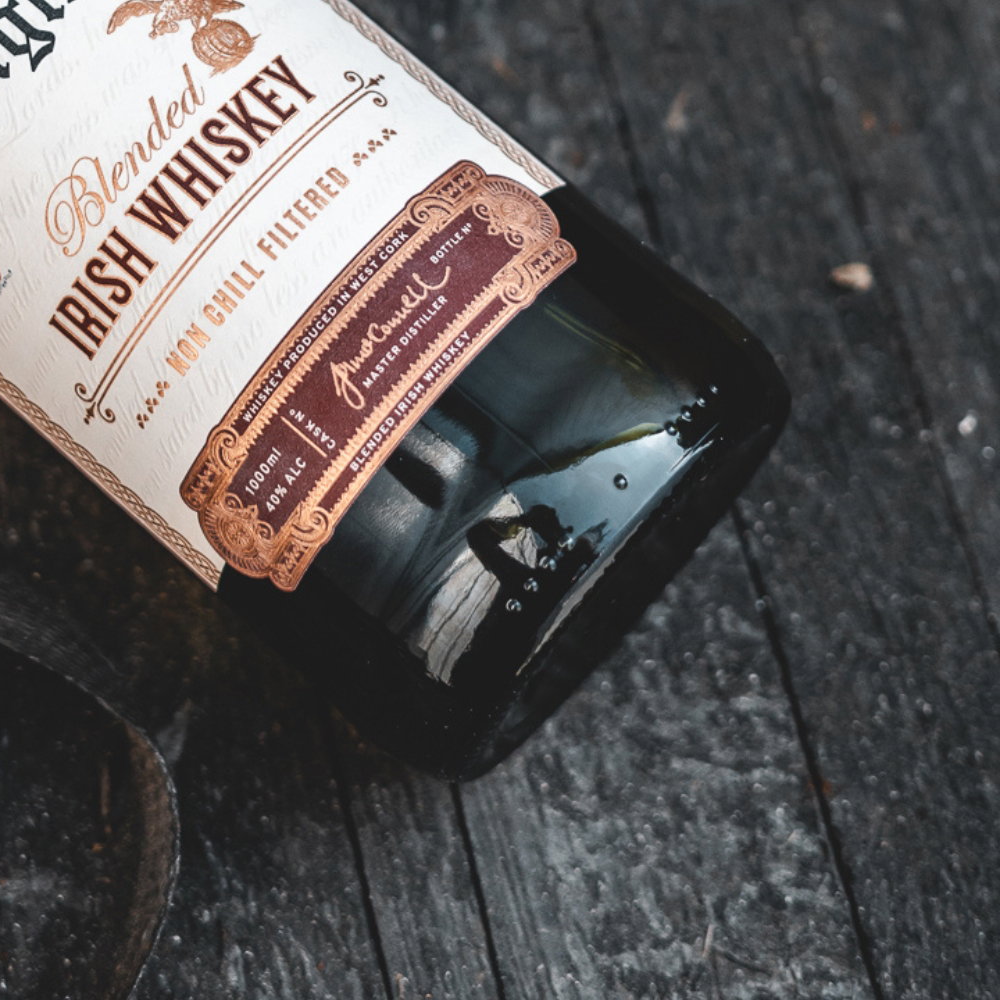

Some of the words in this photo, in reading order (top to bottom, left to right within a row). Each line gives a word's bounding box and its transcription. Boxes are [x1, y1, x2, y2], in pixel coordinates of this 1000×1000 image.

[47, 63, 204, 257] Blended
[49, 227, 154, 360] IRISH
[125, 56, 315, 240] WHISKEY
[165, 322, 210, 376] NON
[203, 260, 264, 326] CHILL
[257, 167, 348, 260] FILTERED
[430, 232, 463, 264] BOTTLE
[241, 370, 287, 425] WHISKEY
[284, 307, 336, 369] PRODUCED
[337, 291, 350, 305] IN
[350, 258, 378, 294] WEST
[379, 226, 408, 264] CORK
[363, 346, 400, 388] MASTER
[400, 296, 447, 345] DISTILLER
[306, 420, 335, 449] CASK
[349, 417, 395, 471] BLENDED
[394, 378, 424, 416] IRISH
[423, 329, 469, 383] WHISKEY
[246, 447, 281, 495] 1000ml
[266, 484, 287, 512] 40%
[285, 458, 306, 485] ALC
